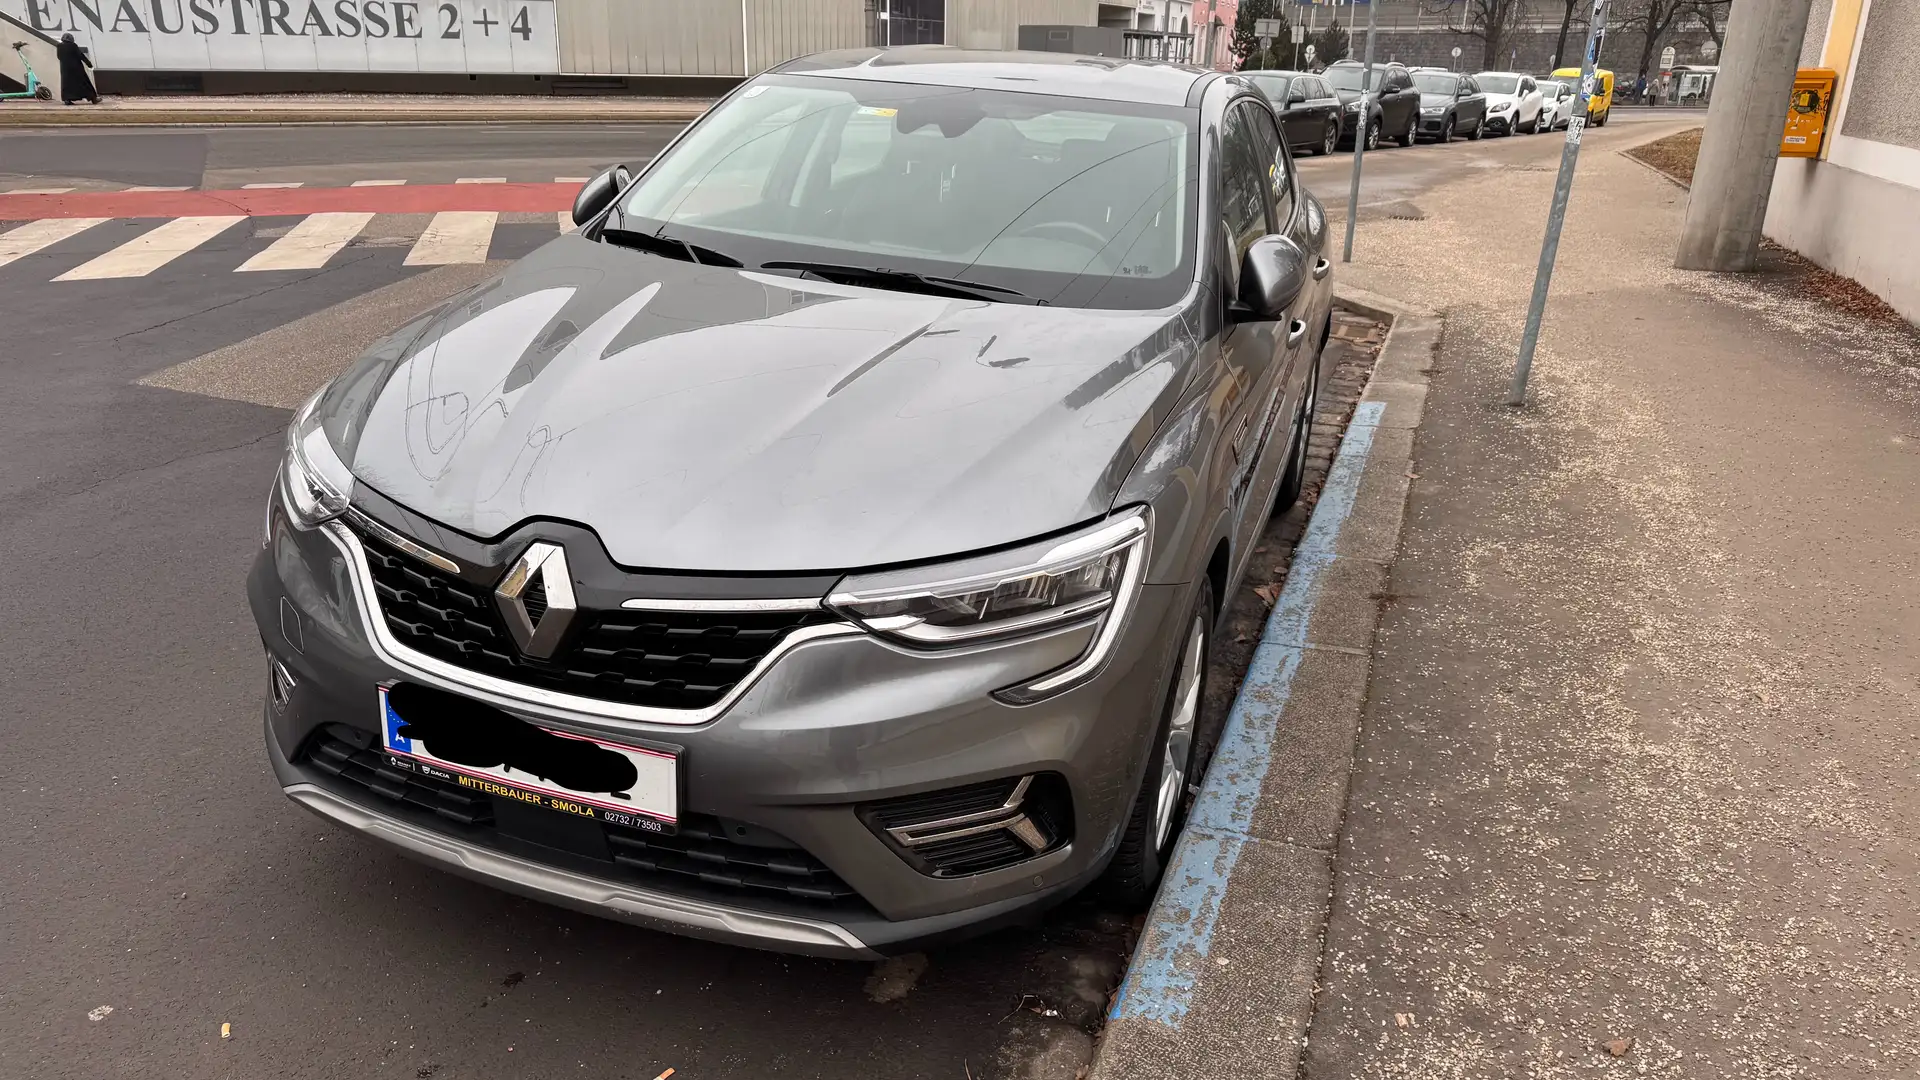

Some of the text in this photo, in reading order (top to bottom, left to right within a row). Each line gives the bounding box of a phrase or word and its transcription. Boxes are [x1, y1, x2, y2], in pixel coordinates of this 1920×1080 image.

[19, 0, 423, 39] ENAUSTRASSE
[430, 769, 450, 779] DACIA
[458, 775, 541, 805] MITTERBAUER
[551, 799, 595, 817] SMOLA
[604, 811, 630, 825] 02732
[636, 818, 662, 832] 73503
